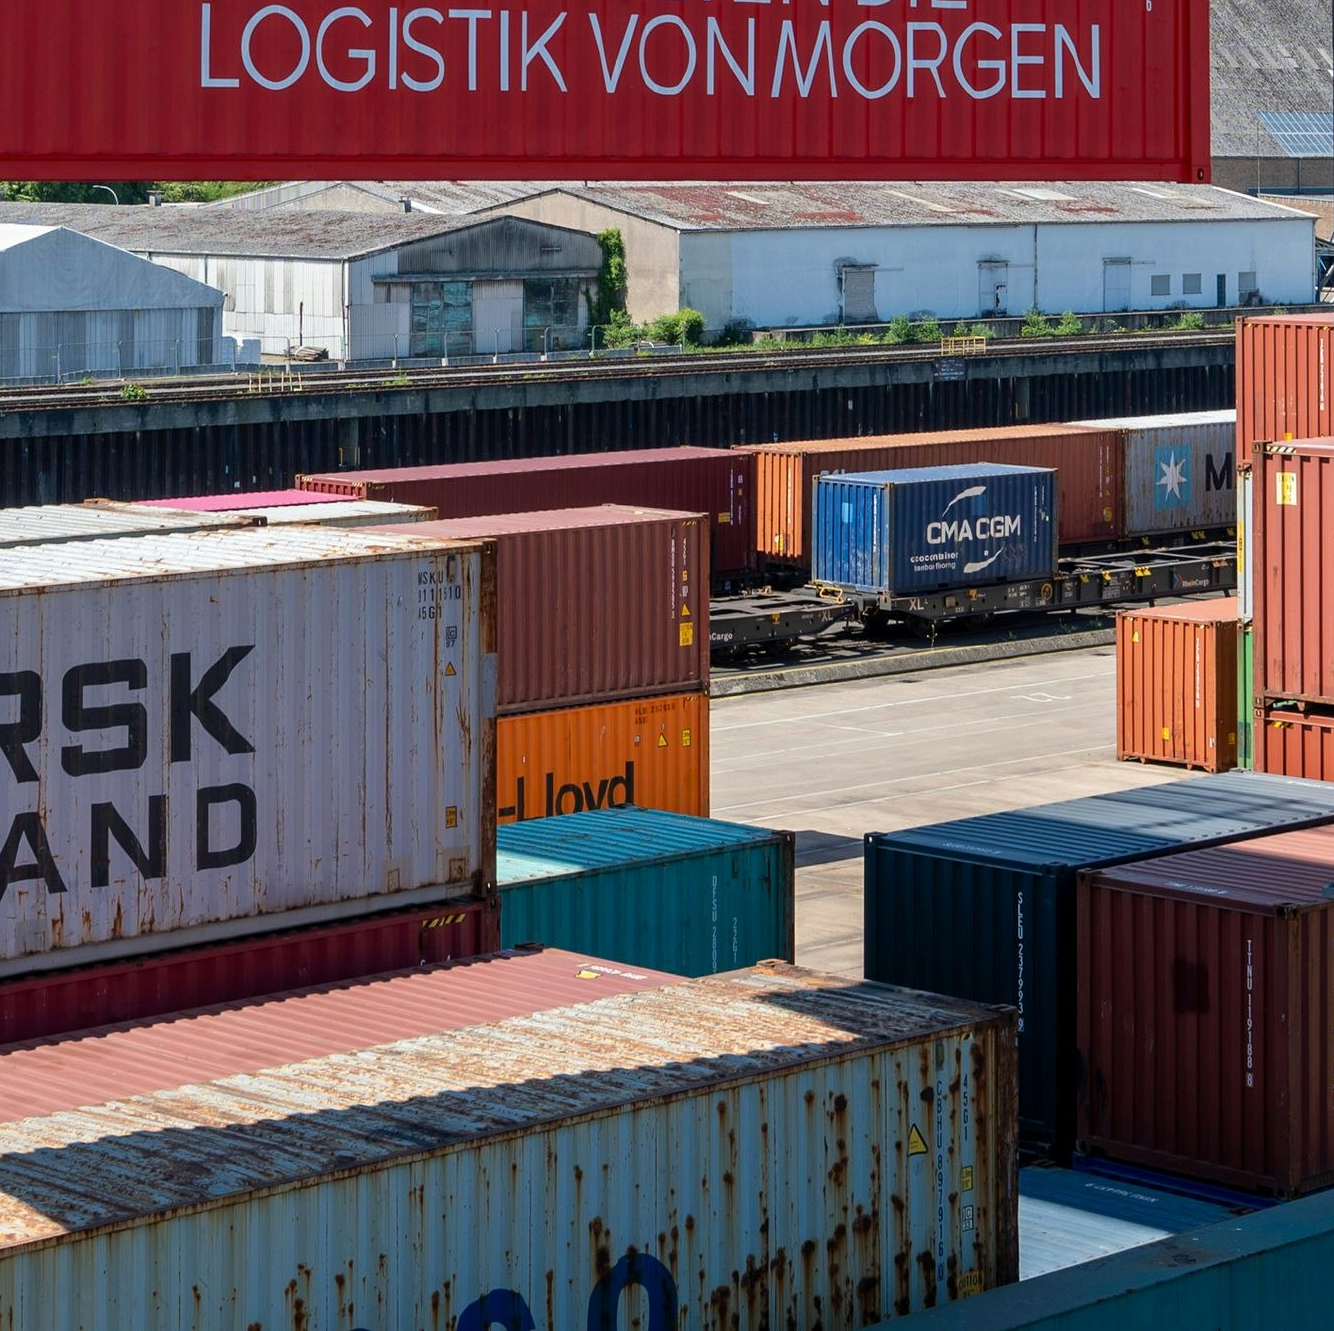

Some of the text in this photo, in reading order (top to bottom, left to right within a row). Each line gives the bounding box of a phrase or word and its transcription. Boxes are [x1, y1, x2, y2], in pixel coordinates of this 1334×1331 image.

[201, 3, 1101, 99] LOGISTIK VON MORGEN
[927, 515, 1021, 545] CMA CGM
